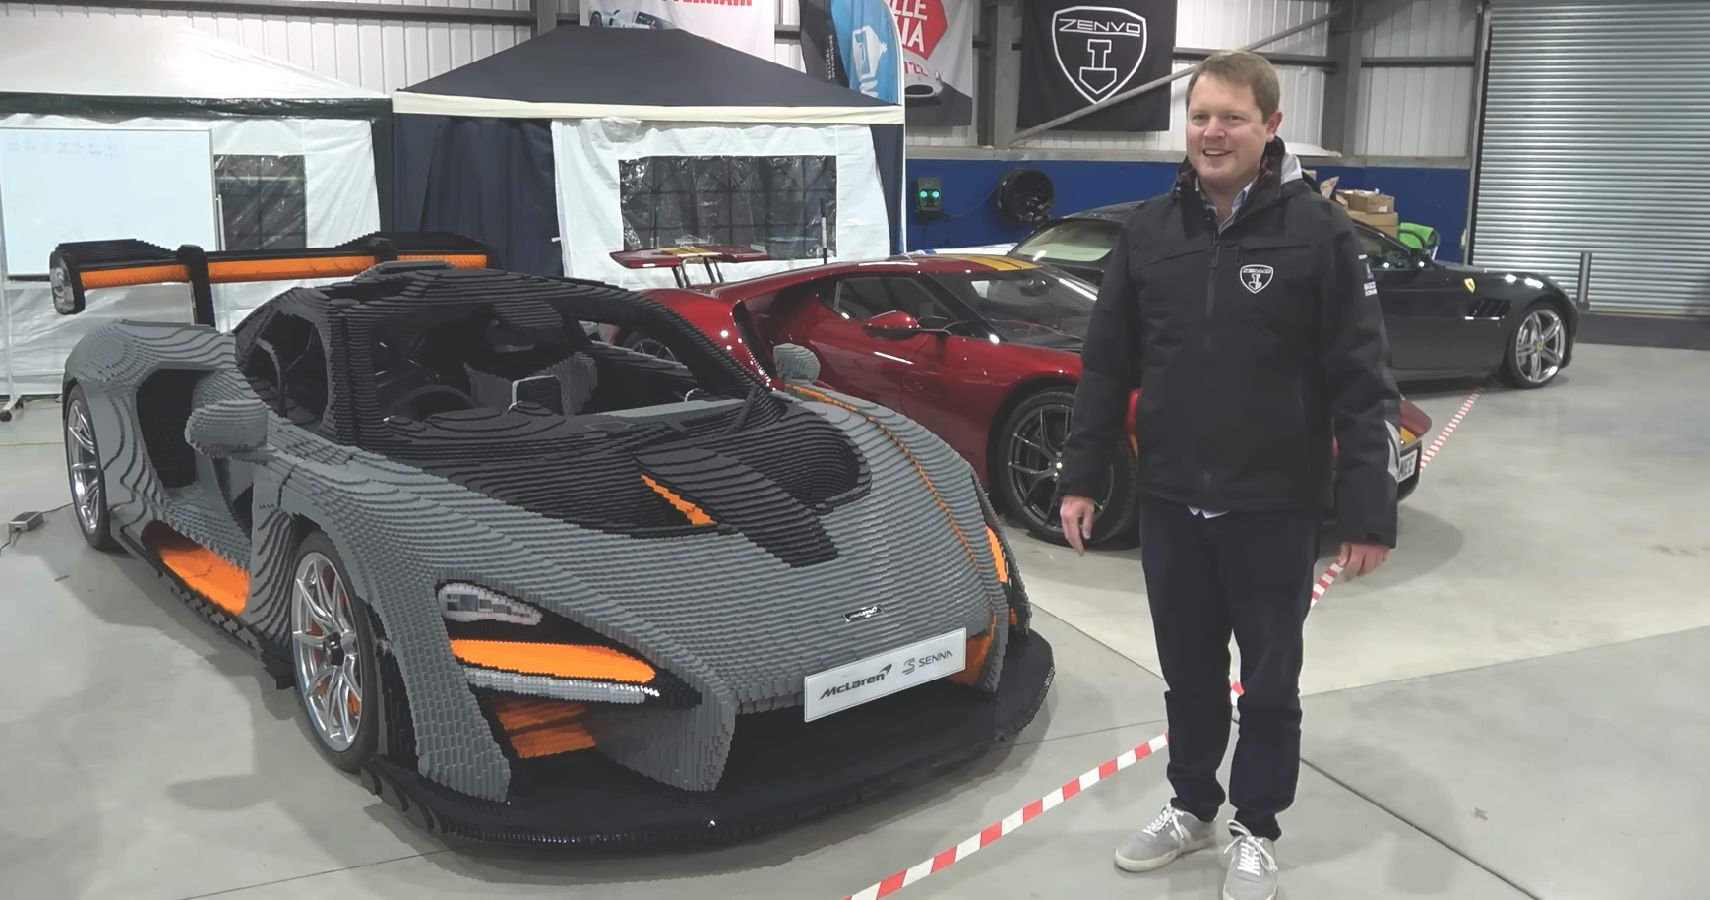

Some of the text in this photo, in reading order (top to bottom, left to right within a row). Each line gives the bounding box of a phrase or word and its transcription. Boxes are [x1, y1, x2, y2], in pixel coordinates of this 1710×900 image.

[898, 17, 925, 53] IA
[1058, 18, 1141, 36] ZENVO
[819, 673, 886, 700] McLaren
[918, 650, 953, 668] SENNA
